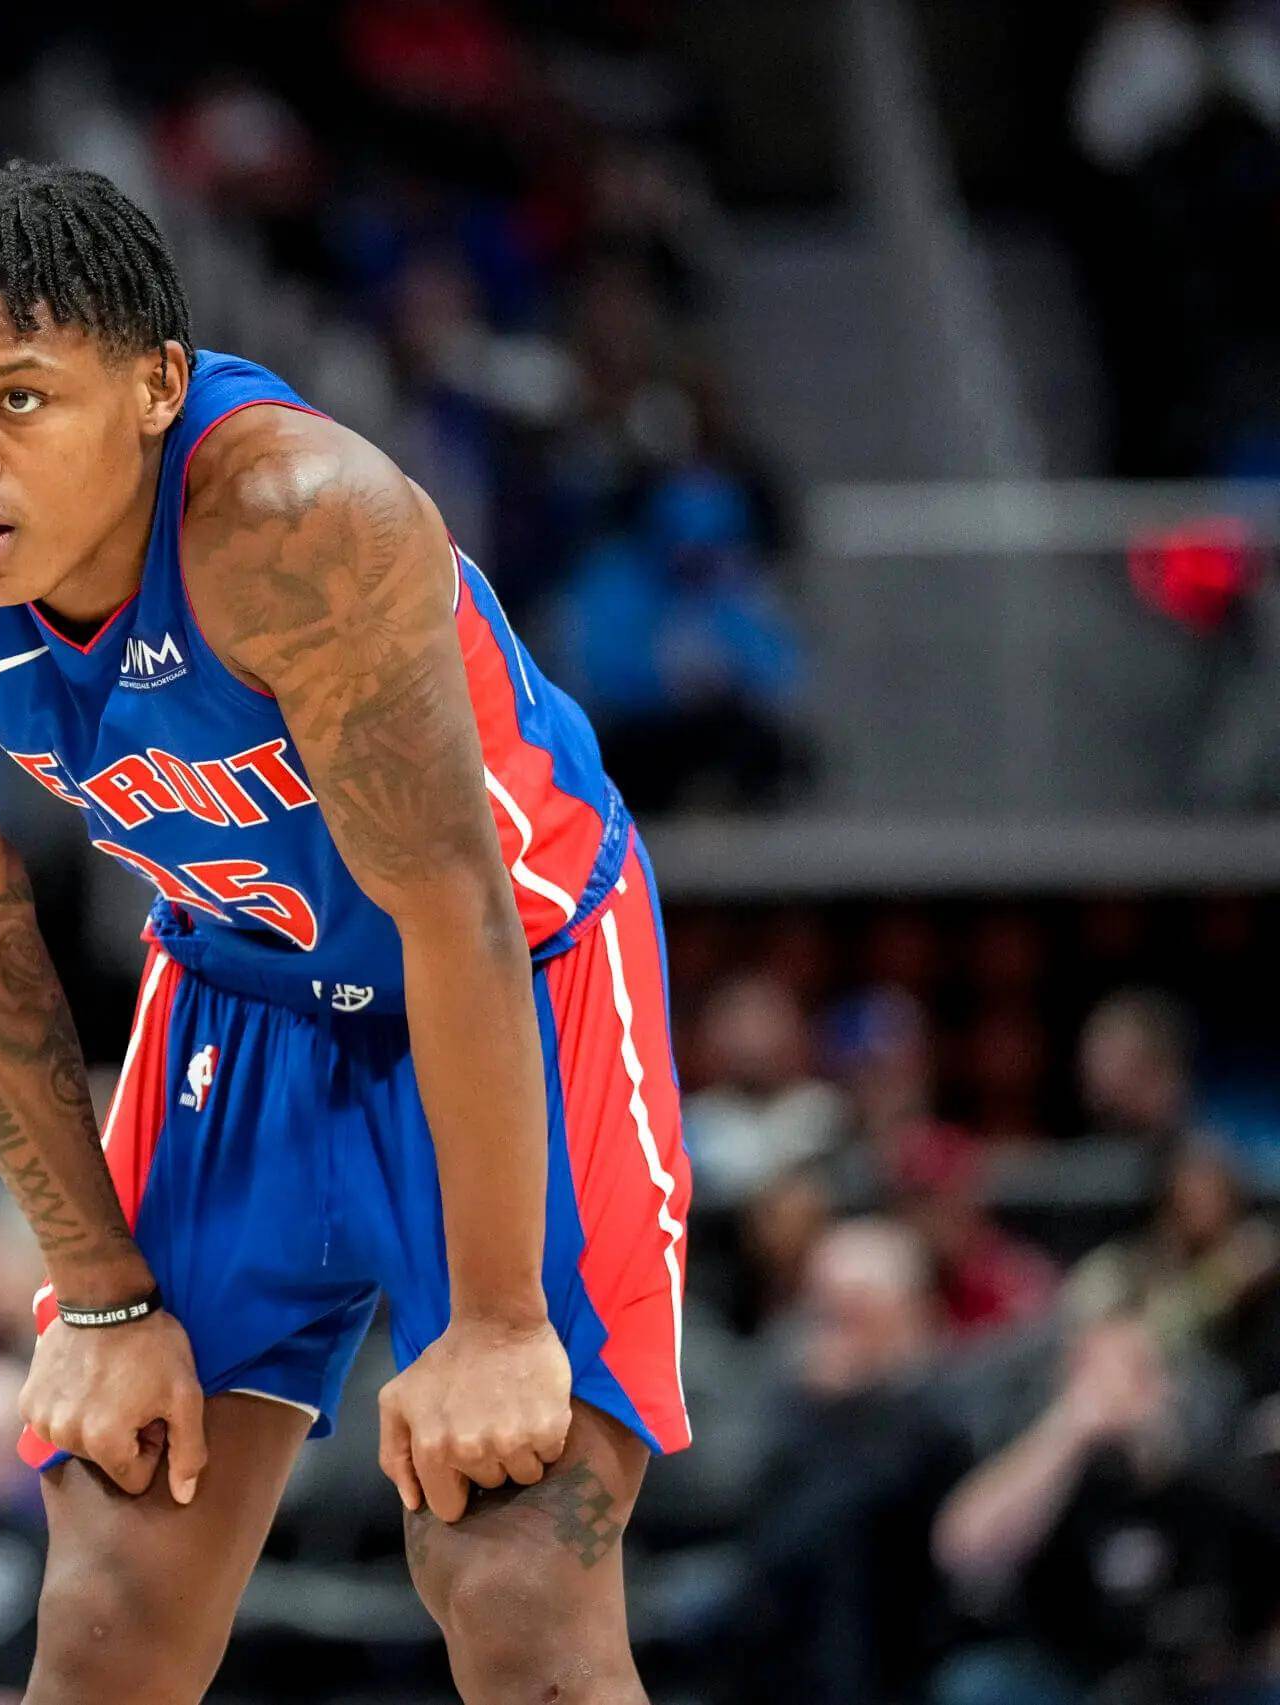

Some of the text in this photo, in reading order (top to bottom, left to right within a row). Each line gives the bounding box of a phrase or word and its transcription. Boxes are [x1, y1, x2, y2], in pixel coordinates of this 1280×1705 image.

[151, 668, 187, 687] MORTGAGE
[6, 737, 320, 831] EROIT
[179, 1092, 196, 1108] NBA
[128, 1301, 149, 1318] BE
